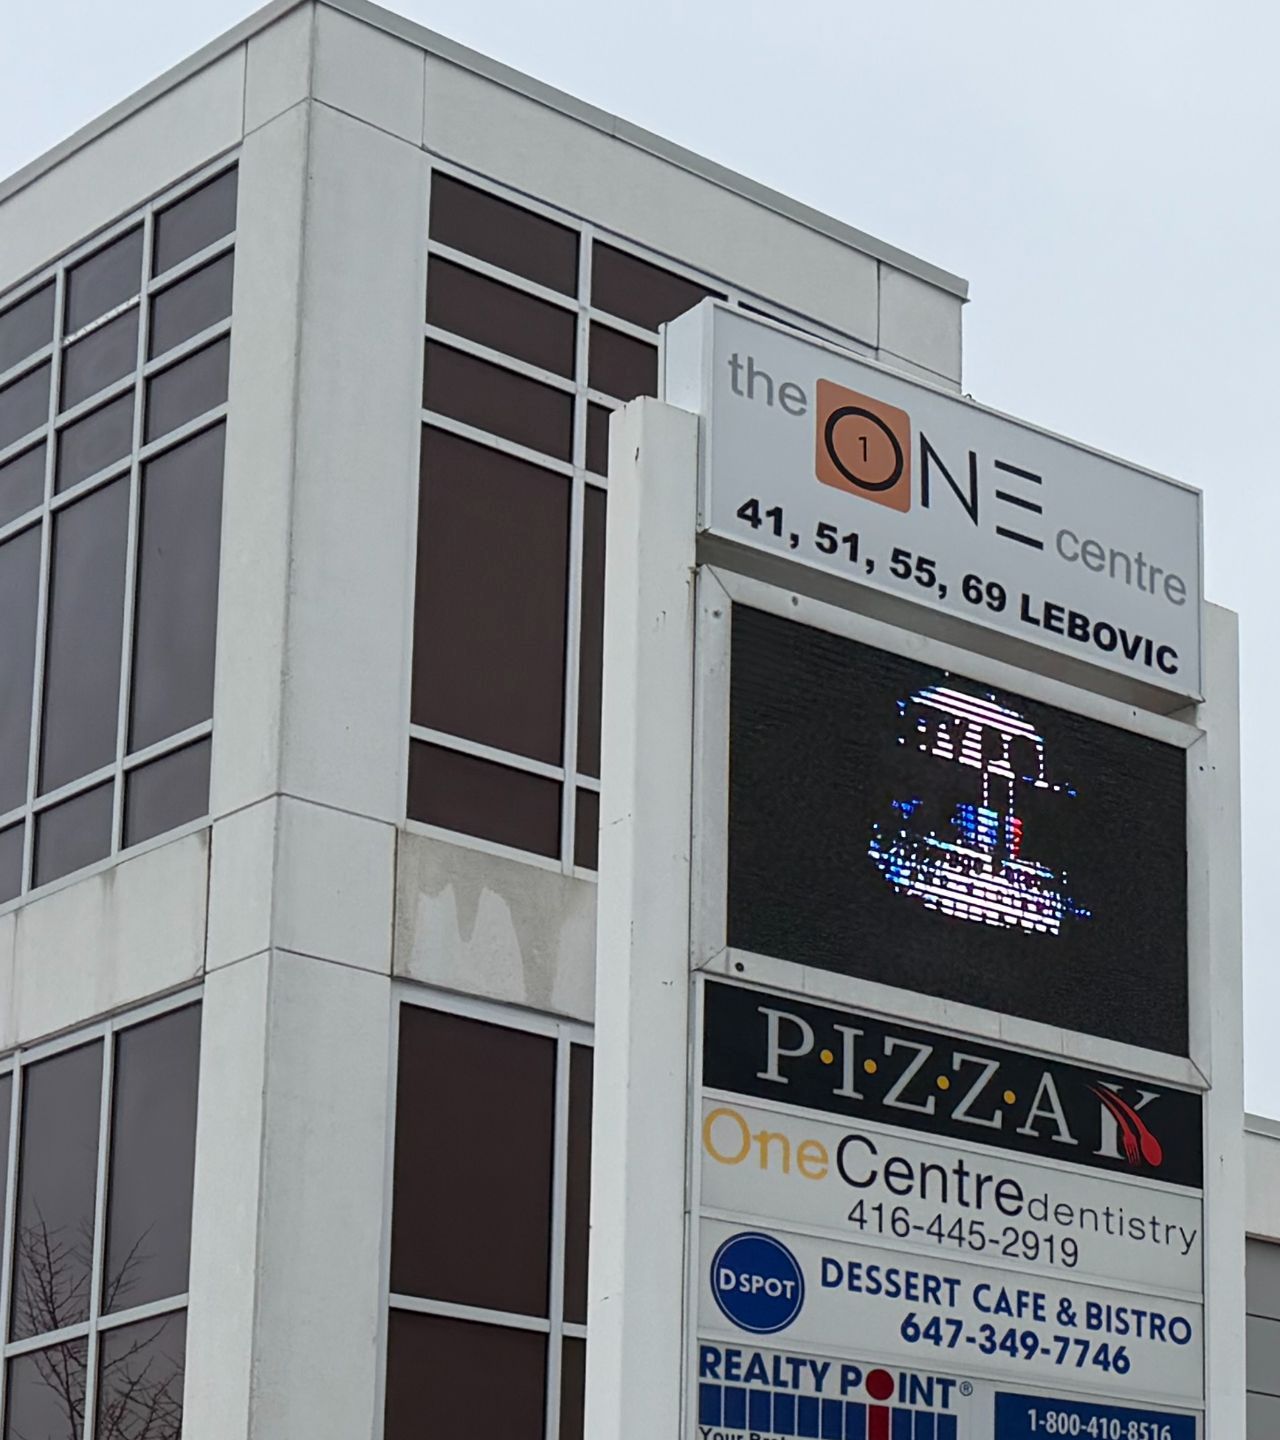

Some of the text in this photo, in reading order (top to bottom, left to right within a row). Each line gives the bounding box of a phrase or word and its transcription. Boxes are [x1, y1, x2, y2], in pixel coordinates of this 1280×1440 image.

[727, 352, 1188, 606] the ONE centre
[736, 498, 1179, 676] 41, 51, 55, 69 LEBOVIC
[848, 1199, 1079, 1269] 416-445-2919
[821, 1256, 1193, 1345] DESSERT CAFE & BISTRO
[699, 1345, 831, 1393] REALTY
[900, 1312, 1131, 1375] 647-349-7746
